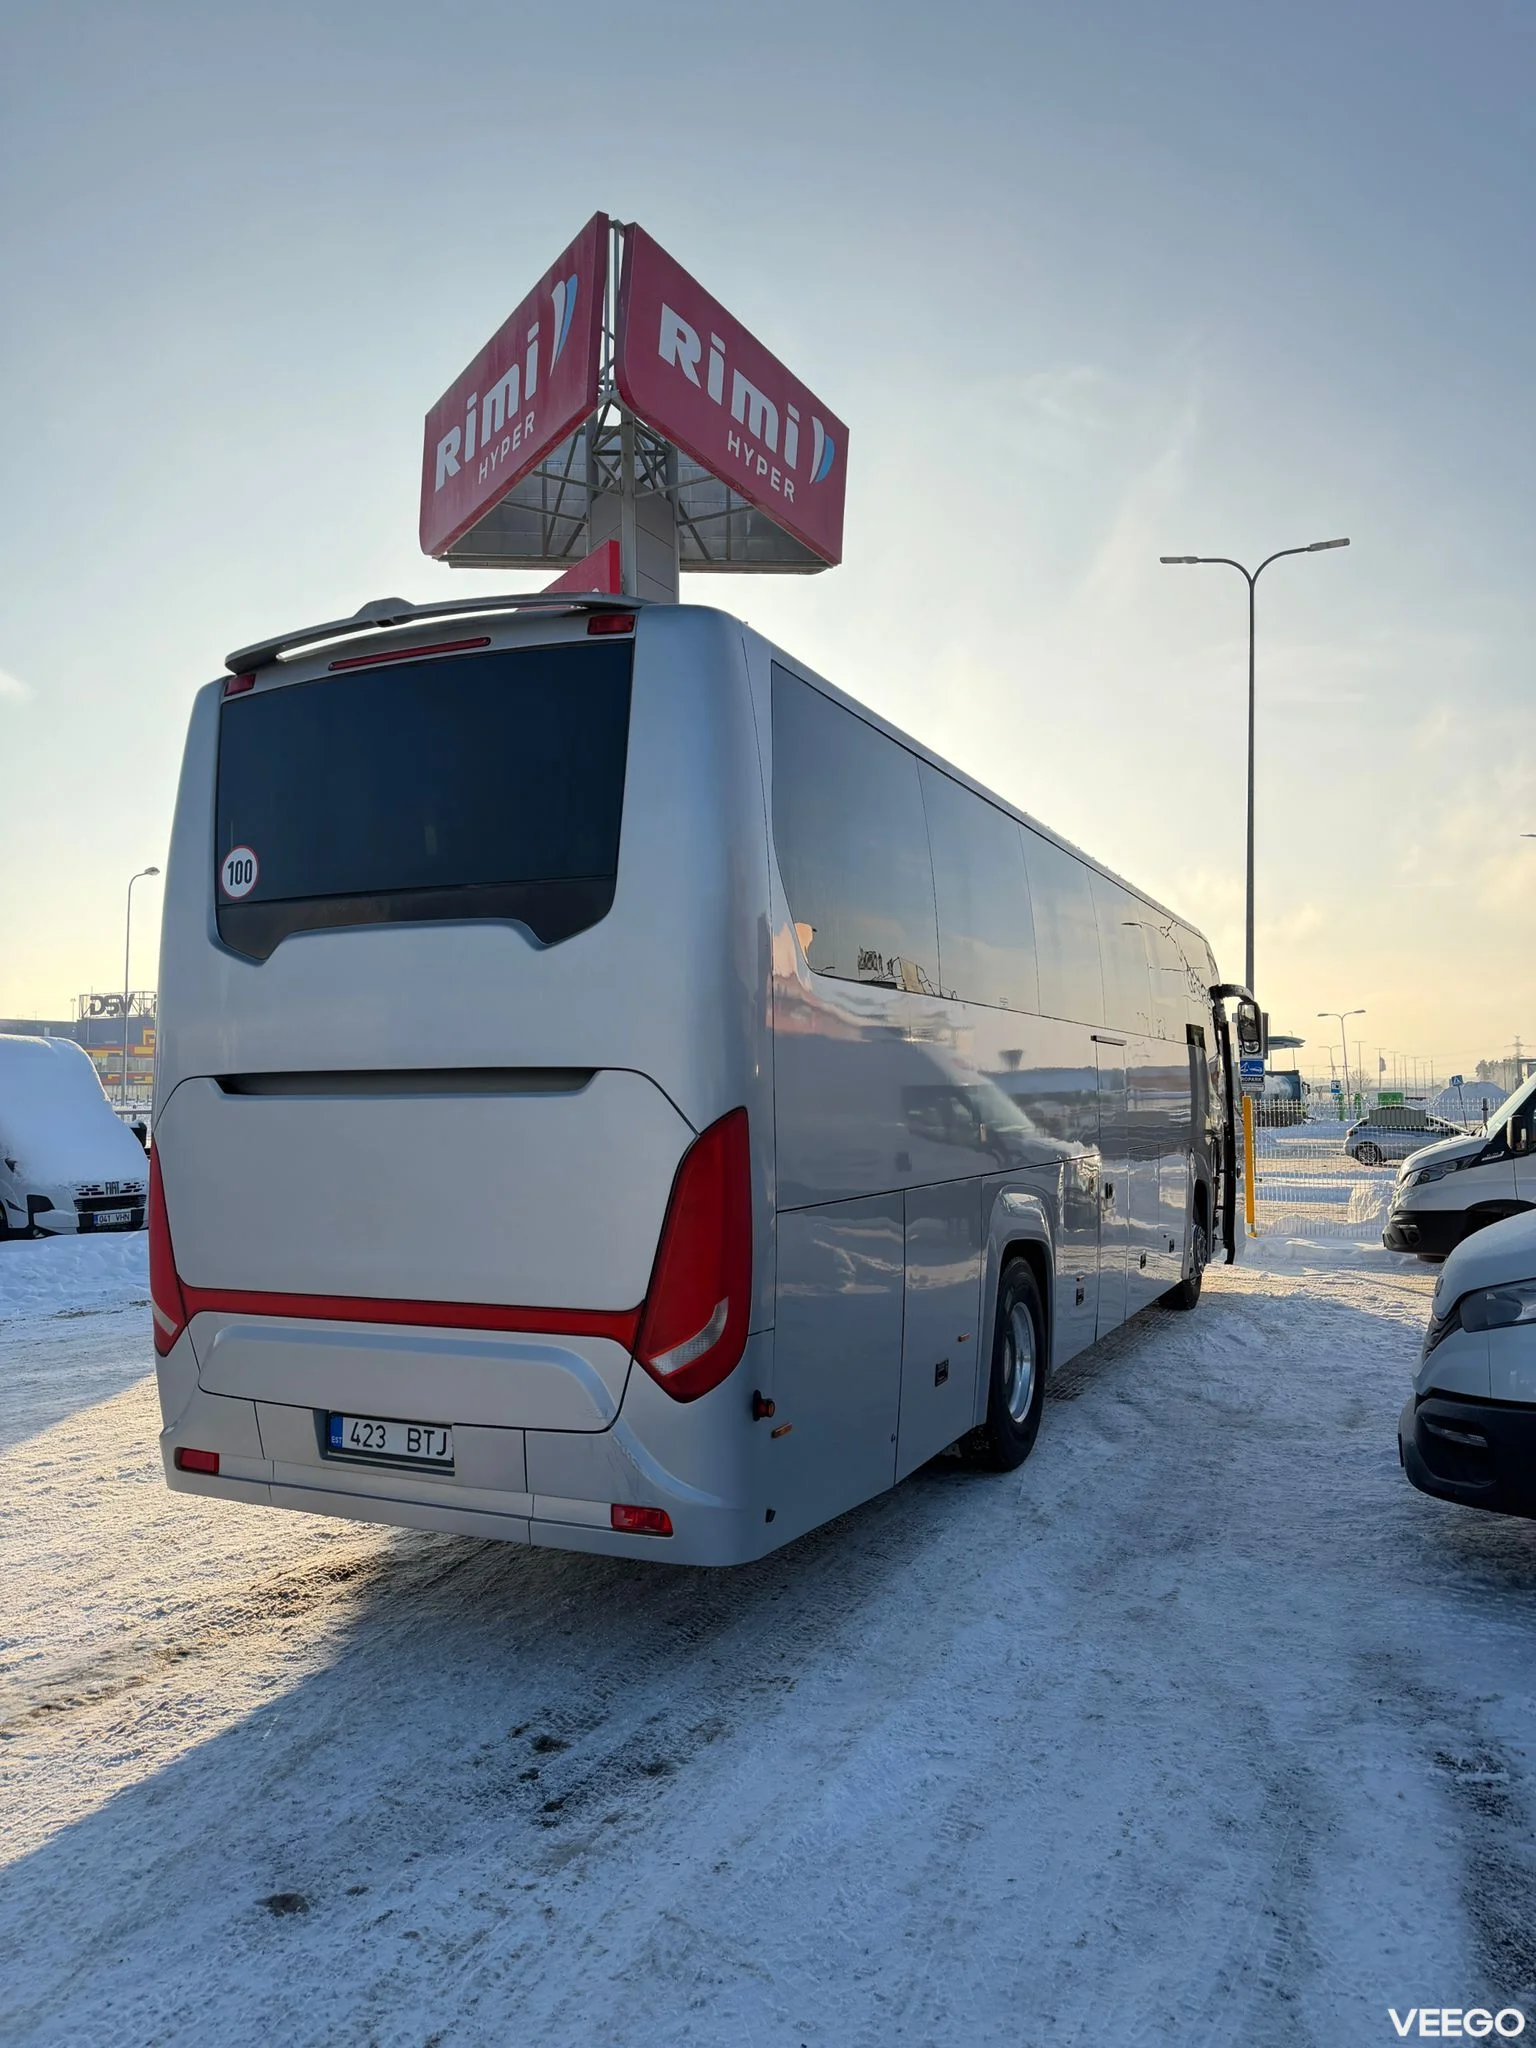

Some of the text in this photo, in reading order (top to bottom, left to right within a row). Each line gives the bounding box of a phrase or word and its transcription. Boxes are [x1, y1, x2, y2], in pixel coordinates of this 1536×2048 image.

[658, 302, 800, 470] Rimi
[434, 321, 539, 493] Rimi
[478, 410, 535, 485] HYPER
[727, 430, 796, 504] HYPER
[227, 858, 253, 886] 100
[90, 993, 135, 1017] DSV
[104, 1180, 120, 1196] FIAT
[331, 1435, 343, 1444] EST
[350, 1421, 448, 1456] 423 BTJ
